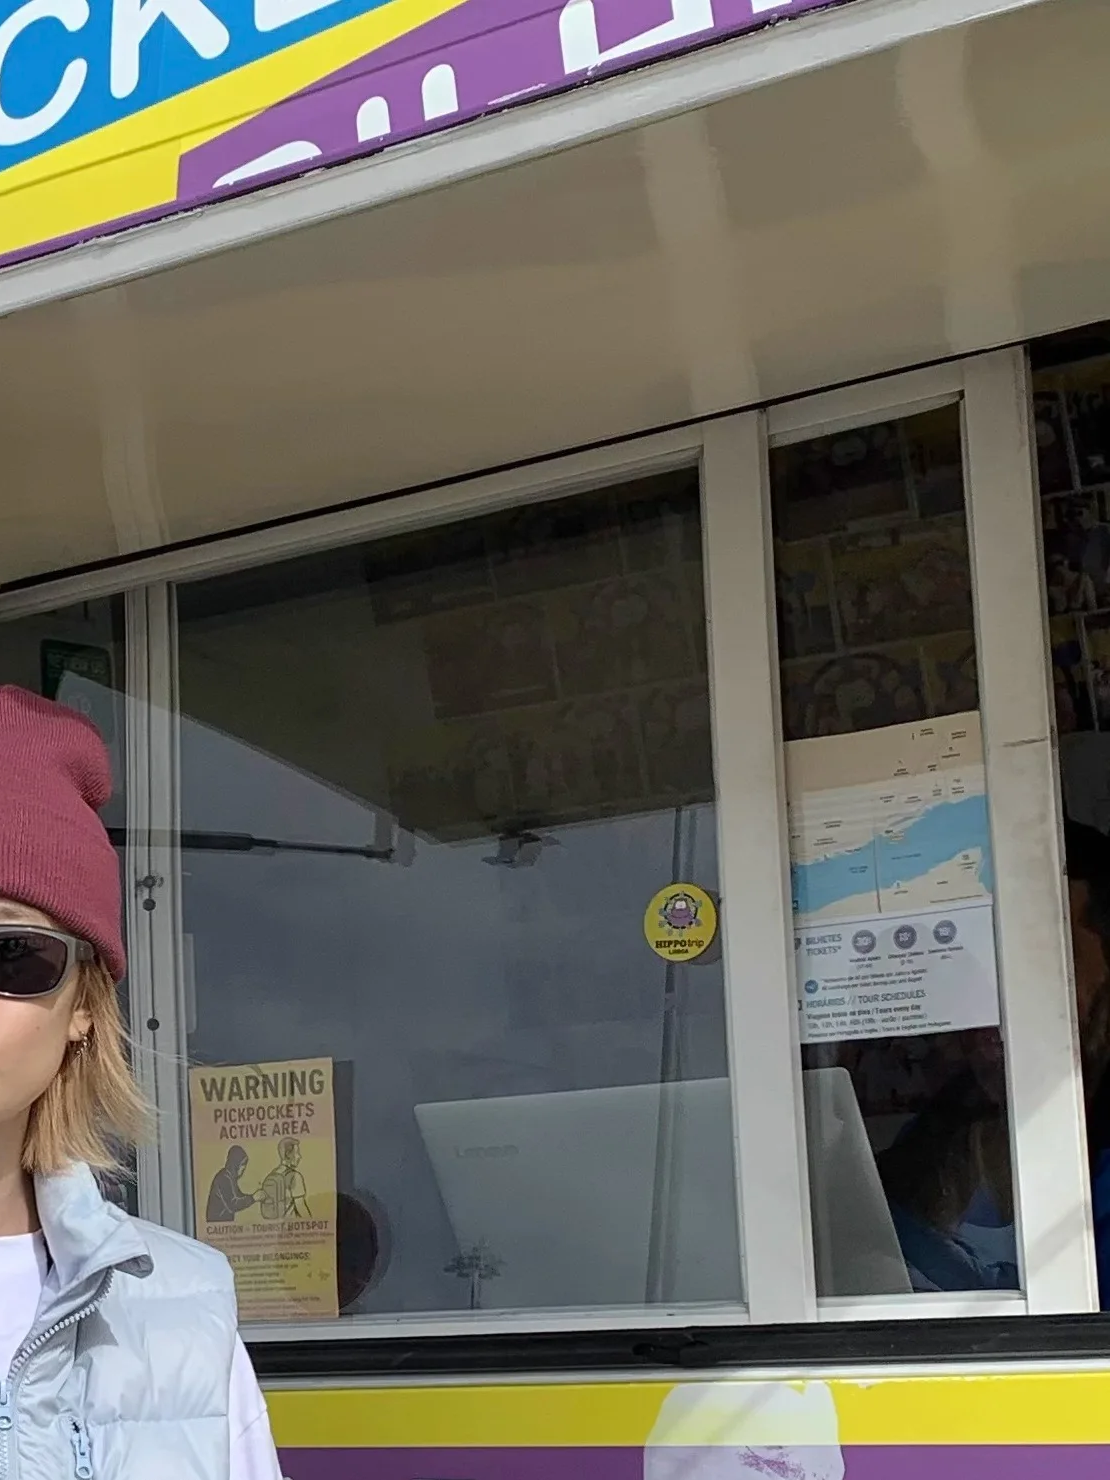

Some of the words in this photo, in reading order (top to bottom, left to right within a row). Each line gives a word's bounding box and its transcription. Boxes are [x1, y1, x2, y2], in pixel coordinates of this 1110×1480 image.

[655, 938, 705, 949] HIPPOtrip
[858, 992, 879, 1004] TOUR
[880, 989, 927, 1002] SCHEDULES
[200, 1068, 325, 1103] WARNING
[213, 1102, 315, 1124] PICKPOCKETS
[218, 1123, 268, 1140] ACTIVE
[272, 1120, 311, 1136] AREA
[206, 1224, 244, 1236] CAUTION
[252, 1222, 286, 1233] TOURIST
[287, 1220, 329, 1231] HOTSPOT
